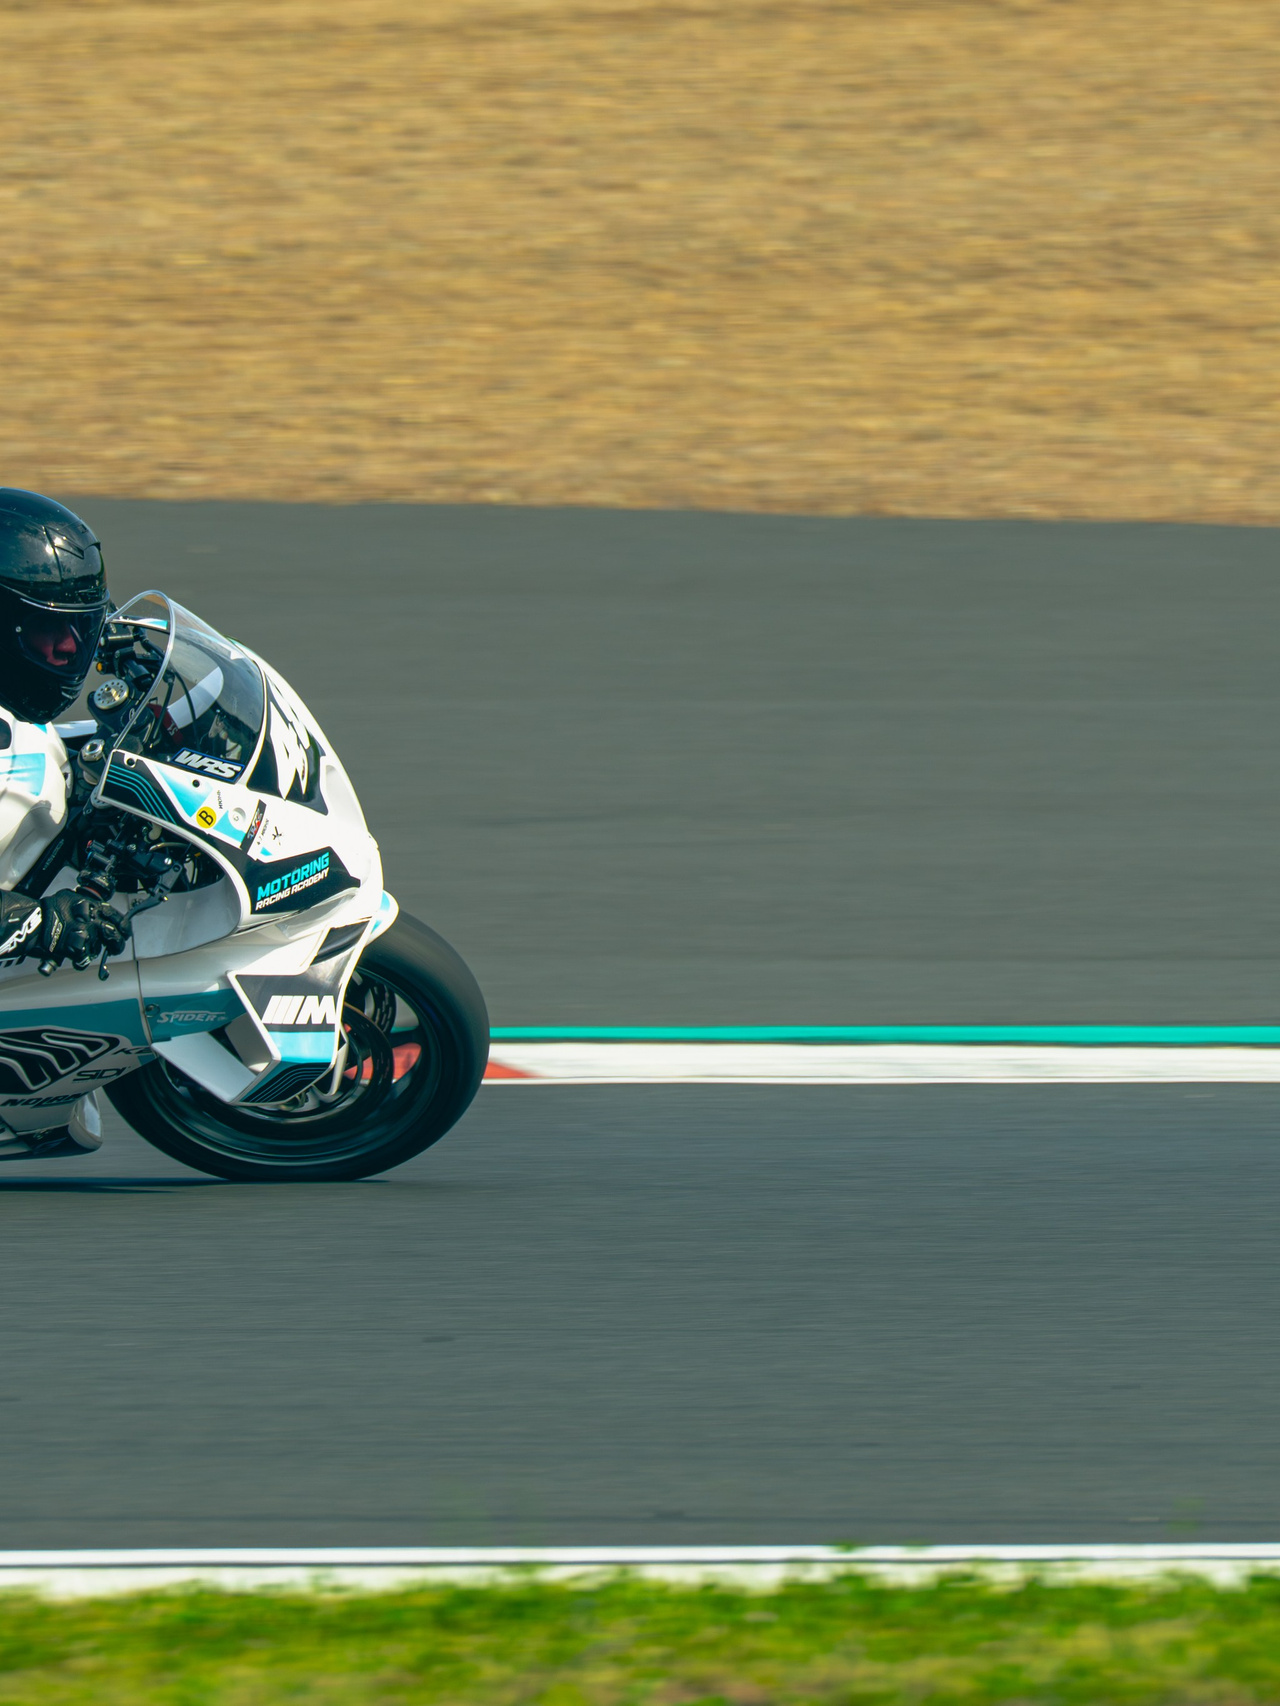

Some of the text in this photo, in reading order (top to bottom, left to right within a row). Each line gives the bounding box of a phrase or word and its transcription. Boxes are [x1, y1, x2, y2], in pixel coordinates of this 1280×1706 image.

[174, 750, 242, 778] WRS
[198, 810, 214, 826] B
[255, 867, 330, 911] RACING ACADEMY
[256, 852, 330, 901] MOTORING
[157, 1010, 221, 1023] SPIDER
